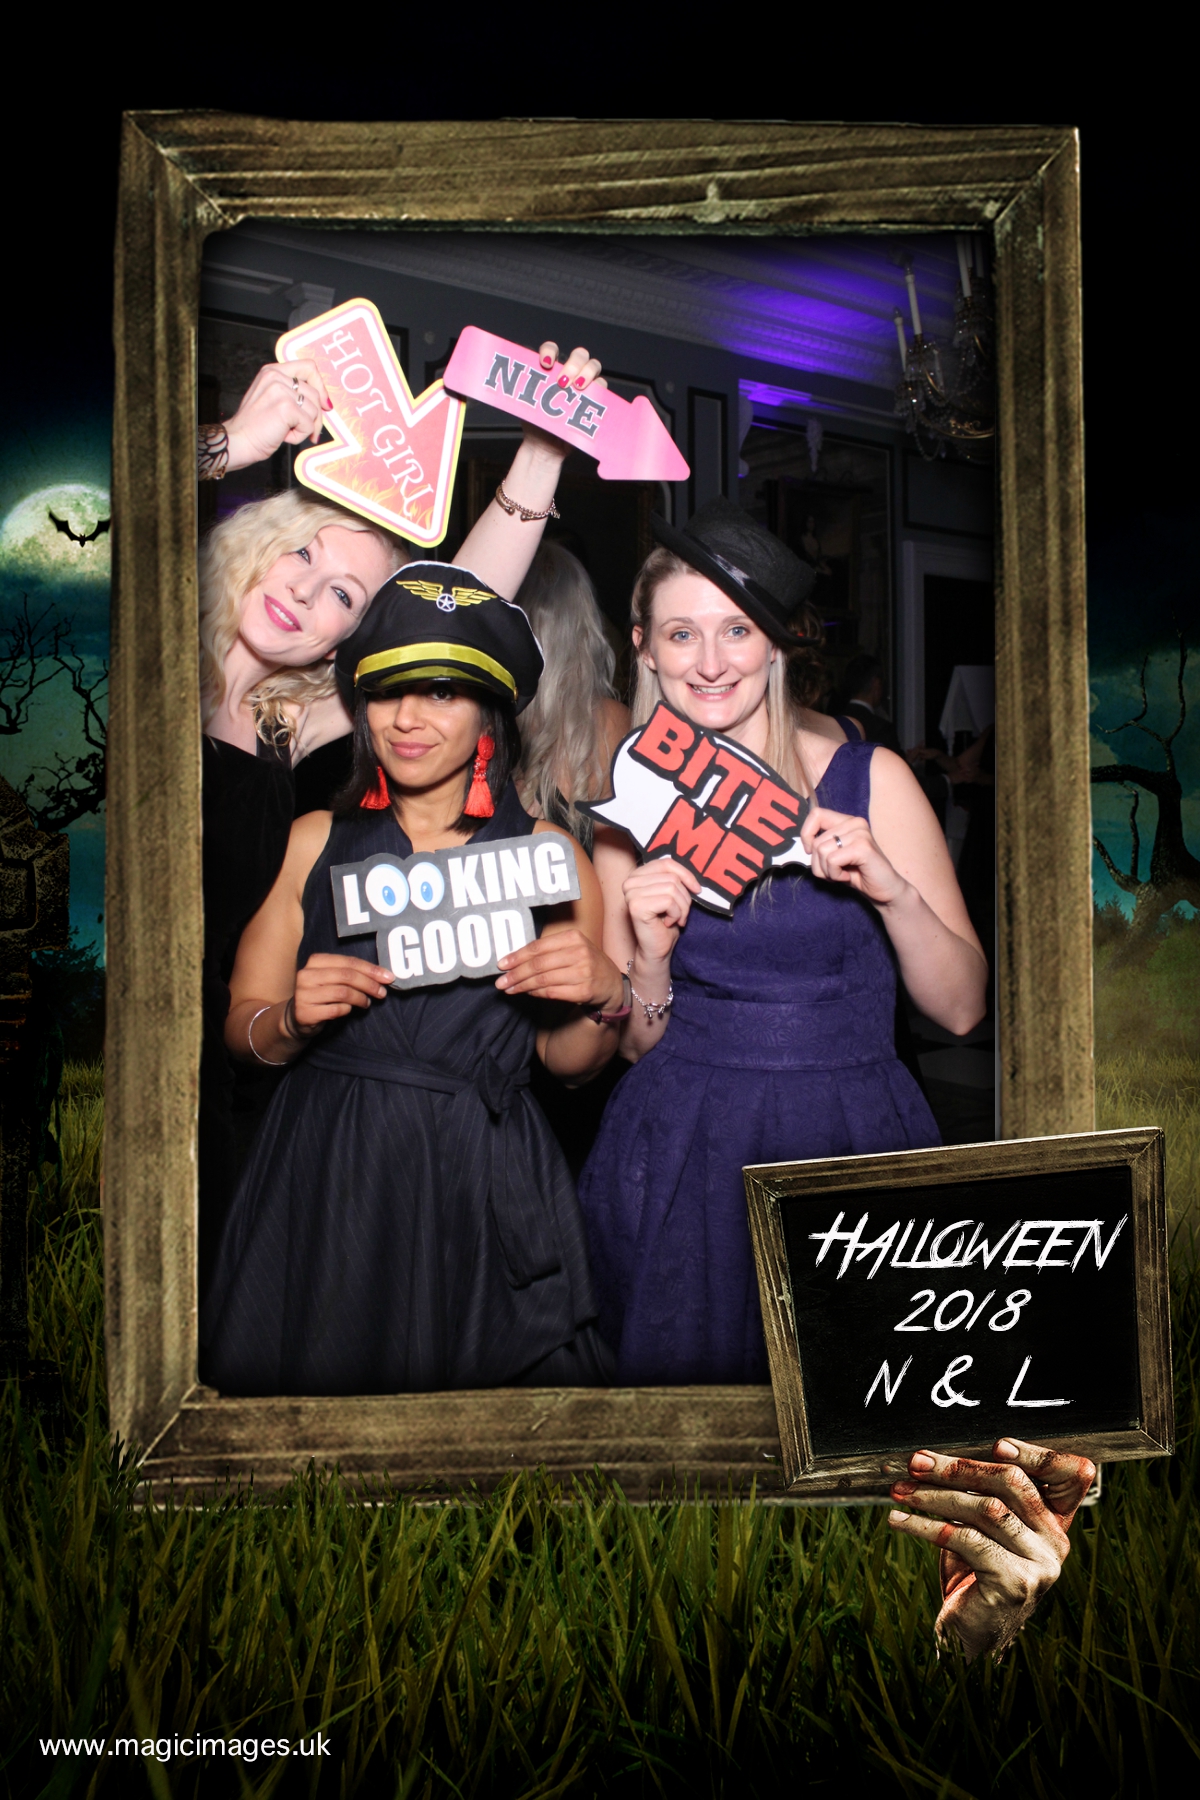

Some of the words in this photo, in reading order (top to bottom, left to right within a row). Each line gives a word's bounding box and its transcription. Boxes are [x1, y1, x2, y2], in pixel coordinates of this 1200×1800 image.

[322, 329, 392, 418] HOT
[372, 423, 434, 517] GIRL
[484, 352, 606, 438] NICE
[633, 704, 800, 847] BITE
[342, 842, 571, 926] LOOKING
[647, 798, 765, 897] ME
[387, 909, 527, 980] GOOD
